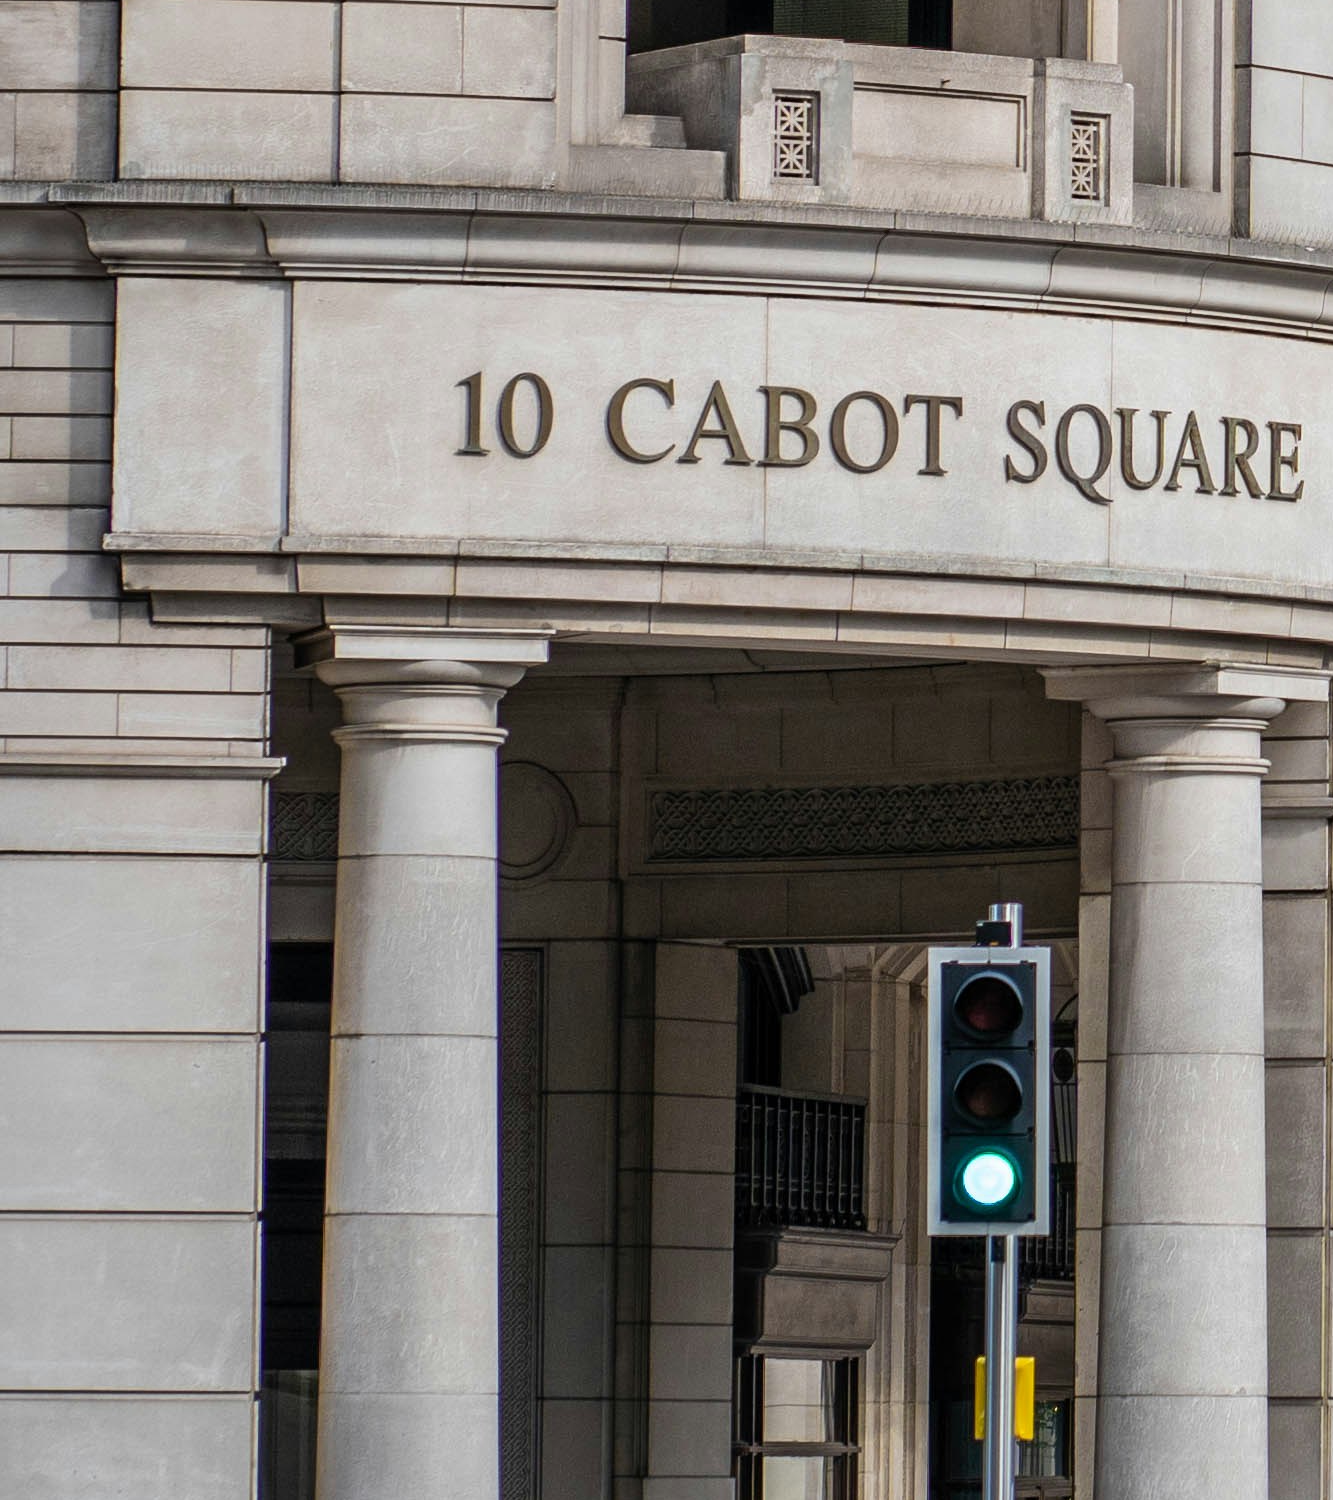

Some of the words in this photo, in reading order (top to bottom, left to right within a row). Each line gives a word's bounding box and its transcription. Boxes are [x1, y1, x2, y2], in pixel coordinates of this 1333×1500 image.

[454, 370, 554, 459] 10
[605, 376, 964, 478] CABOT
[1004, 398, 1306, 506] SQUARE
